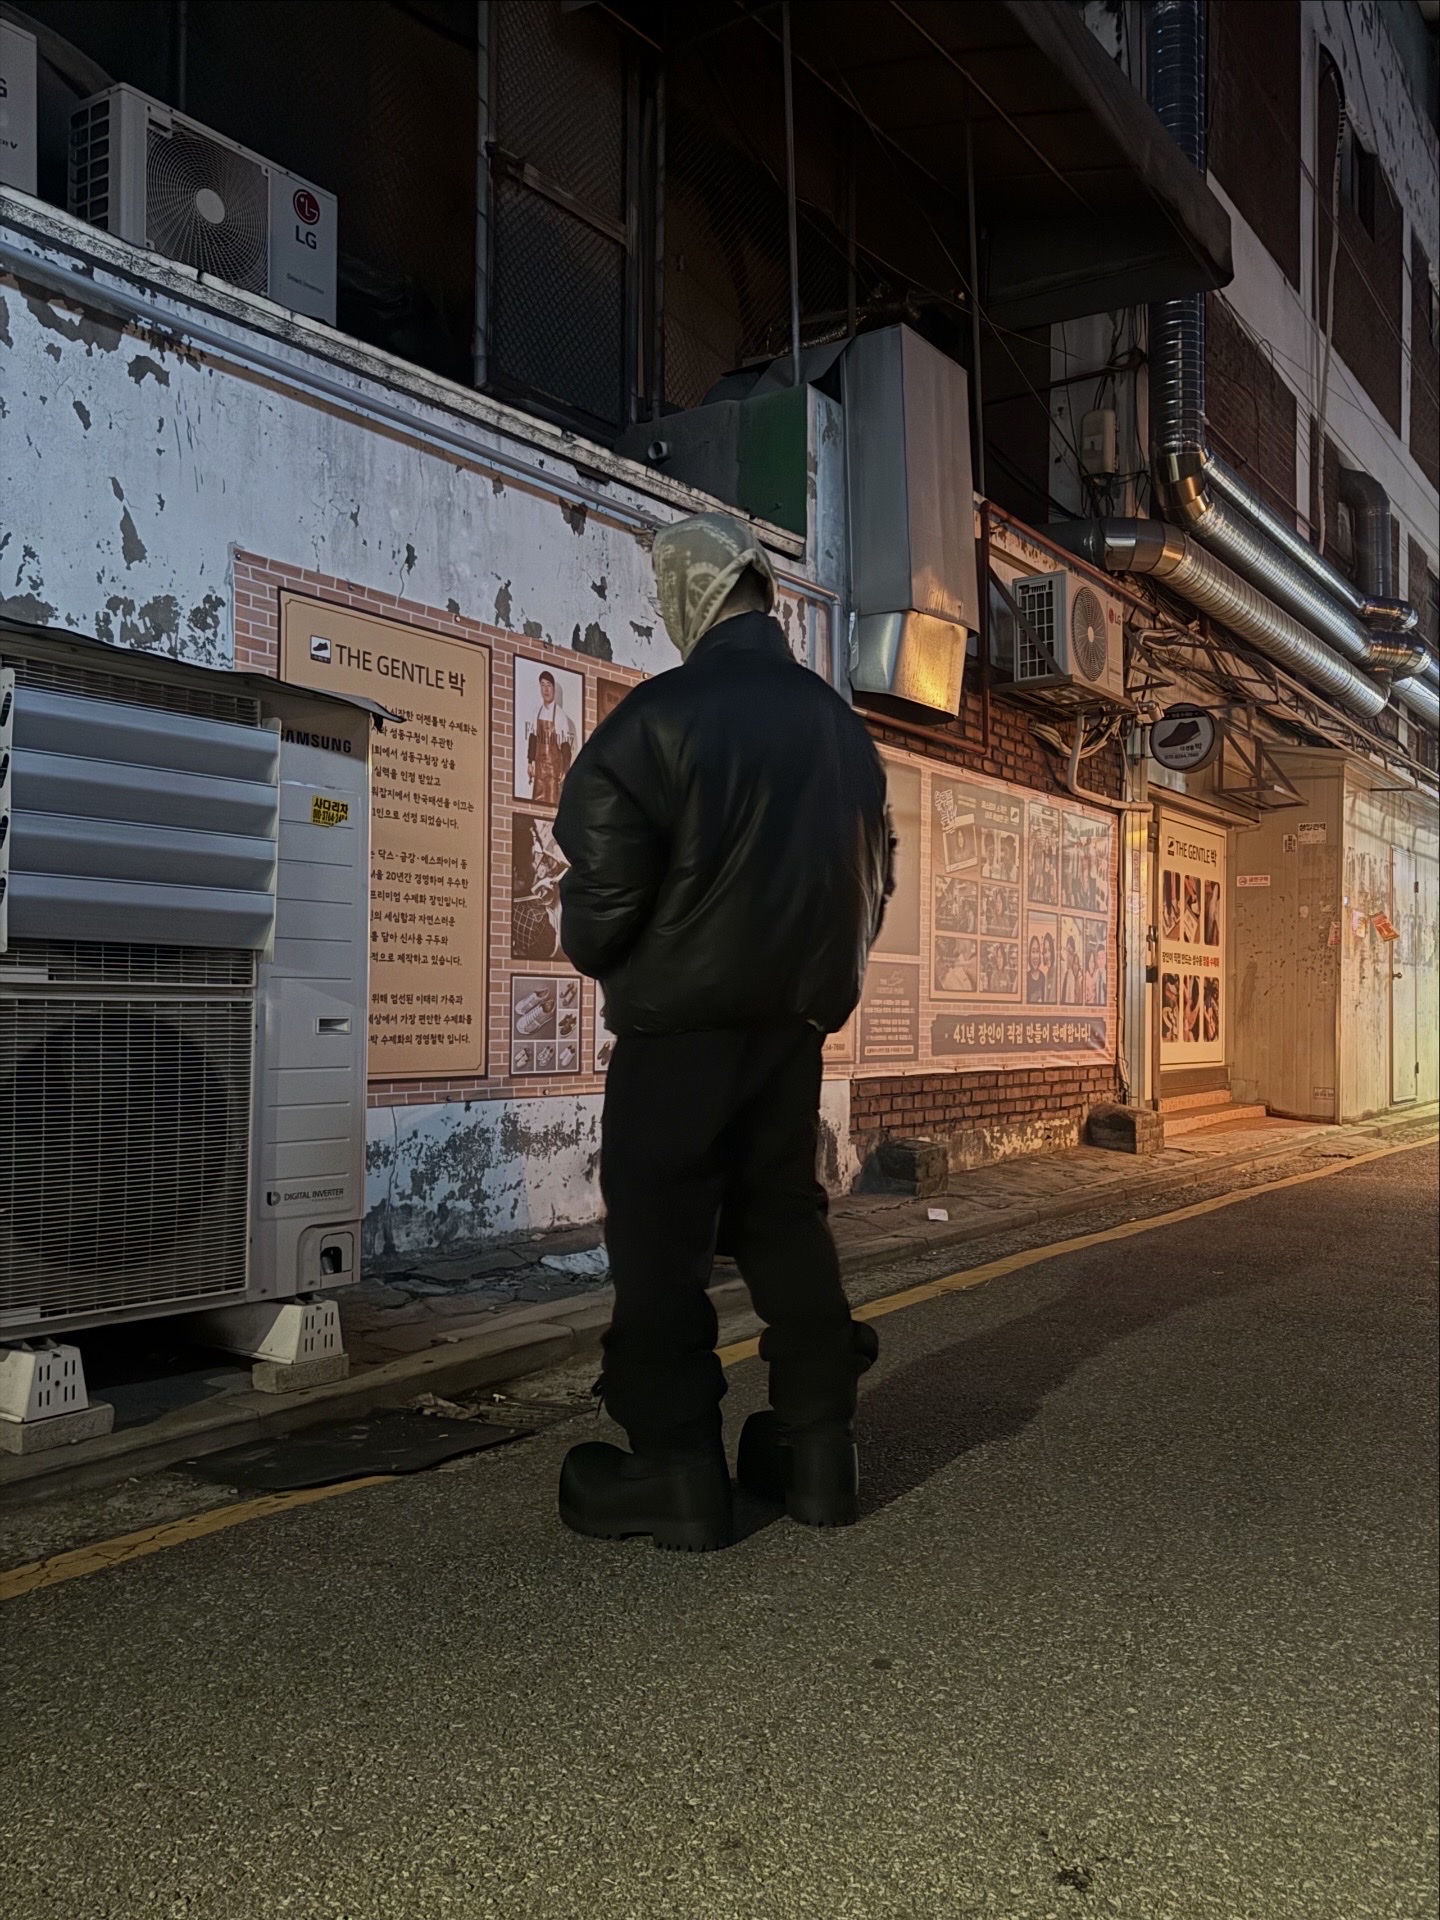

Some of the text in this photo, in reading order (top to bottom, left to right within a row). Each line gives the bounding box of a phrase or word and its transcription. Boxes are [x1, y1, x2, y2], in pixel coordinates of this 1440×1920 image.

[295, 225, 317, 250] LG
[335, 643, 466, 696] THE GENTLE 박
[448, 720, 478, 736] 수제화는
[390, 727, 428, 745] 성동구청이
[431, 735, 454, 751] 주관한
[401, 750, 439, 768] 성동구청장
[441, 757, 456, 771] 상을
[374, 765, 442, 787] 실력을 인정 받았고
[314, 797, 349, 815] 사다리차
[453, 799, 475, 813] 이끄는
[402, 811, 418, 824] 선정
[420, 814, 459, 829] 되었습니다.
[1175, 840, 1217, 868] THE GENTLE 박
[386, 870, 412, 884] 20년간
[415, 873, 445, 887] 경영하며
[447, 877, 469, 889] 우수한
[370, 889, 468, 908] 프리미엄 수제화 장인입니다.
[385, 910, 417, 924] 세심함과
[419, 913, 456, 927] 자연스러운
[381, 931, 398, 943] 담아
[426, 934, 449, 945] 구두와
[397, 952, 428, 965] 제작하고
[431, 954, 463, 966] 있습니다.
[372, 993, 463, 1005] 위해 엄선된 이태리 가죽과
[400, 1013, 416, 1026] 가장
[418, 1013, 442, 1025] 편안한
[368, 1033, 471, 1046] 박 수제화의 경영철학 입니다.
[953, 1022, 1091, 1045] 41년 장인이 직접 만들어 판매합니다!
[284, 1191, 310, 1201] DIGITAL
[312, 1187, 344, 1198] INVERTER
